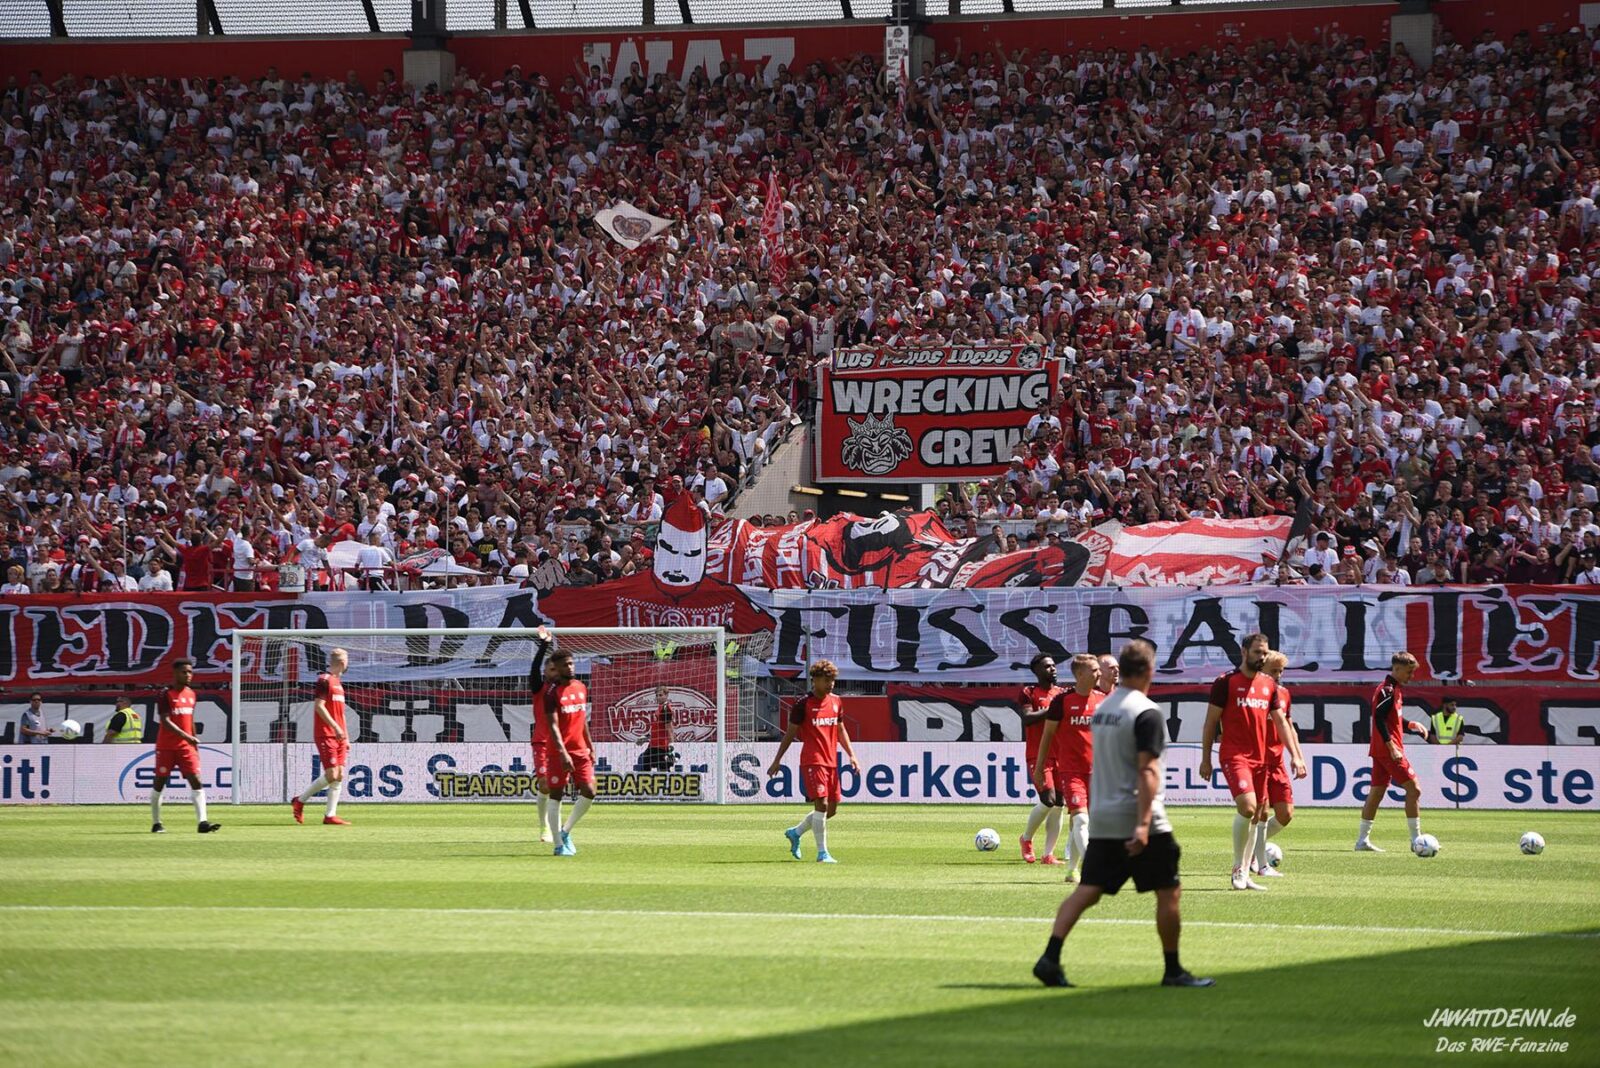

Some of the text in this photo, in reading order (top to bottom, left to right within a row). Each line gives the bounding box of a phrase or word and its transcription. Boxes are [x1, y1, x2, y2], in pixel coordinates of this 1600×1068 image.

[837, 351, 875, 369] LOS
[832, 373, 1049, 414] WRECKING
[2, 754, 50, 798] it!
[730, 752, 1037, 798] Saberkeit!
[1503, 760, 1595, 805] ste
